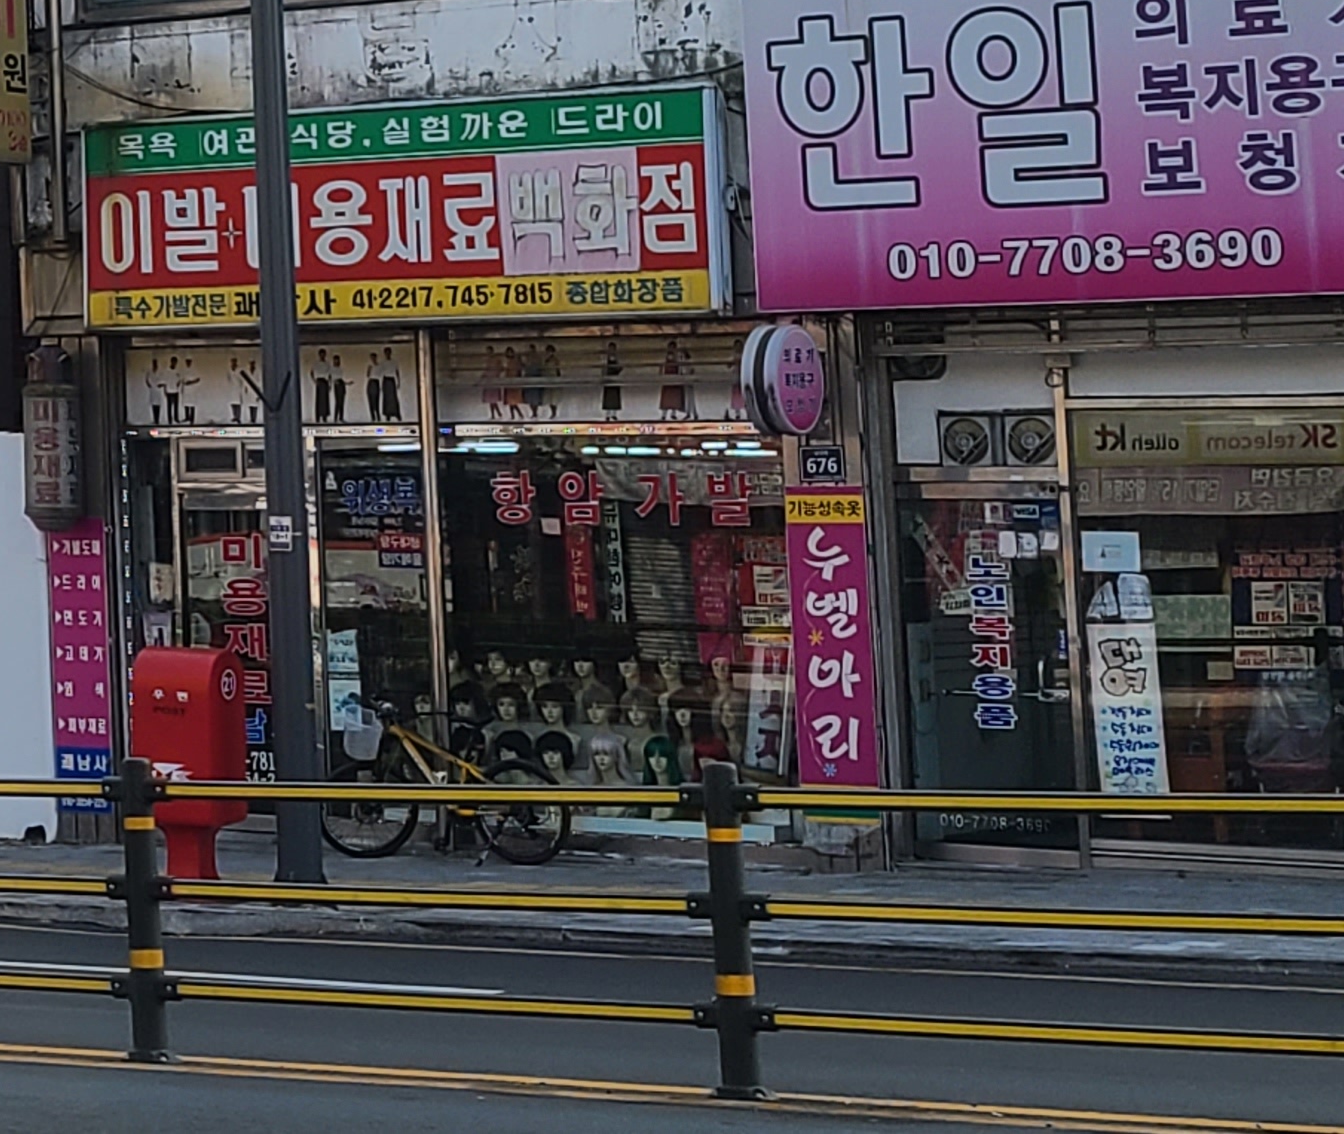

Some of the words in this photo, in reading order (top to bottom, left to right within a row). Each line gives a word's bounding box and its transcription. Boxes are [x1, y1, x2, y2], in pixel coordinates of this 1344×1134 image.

[765, 0, 1111, 212] 한일
[1138, 53, 1344, 123] 복지용
[116, 129, 179, 160] 목욕
[555, 100, 664, 135] 드라이
[888, 227, 1284, 282] 010-7708-3690
[806, 457, 838, 474] 676
[788, 499, 862, 517] 기능성속옷
[967, 556, 1017, 730] 노인복지용품
